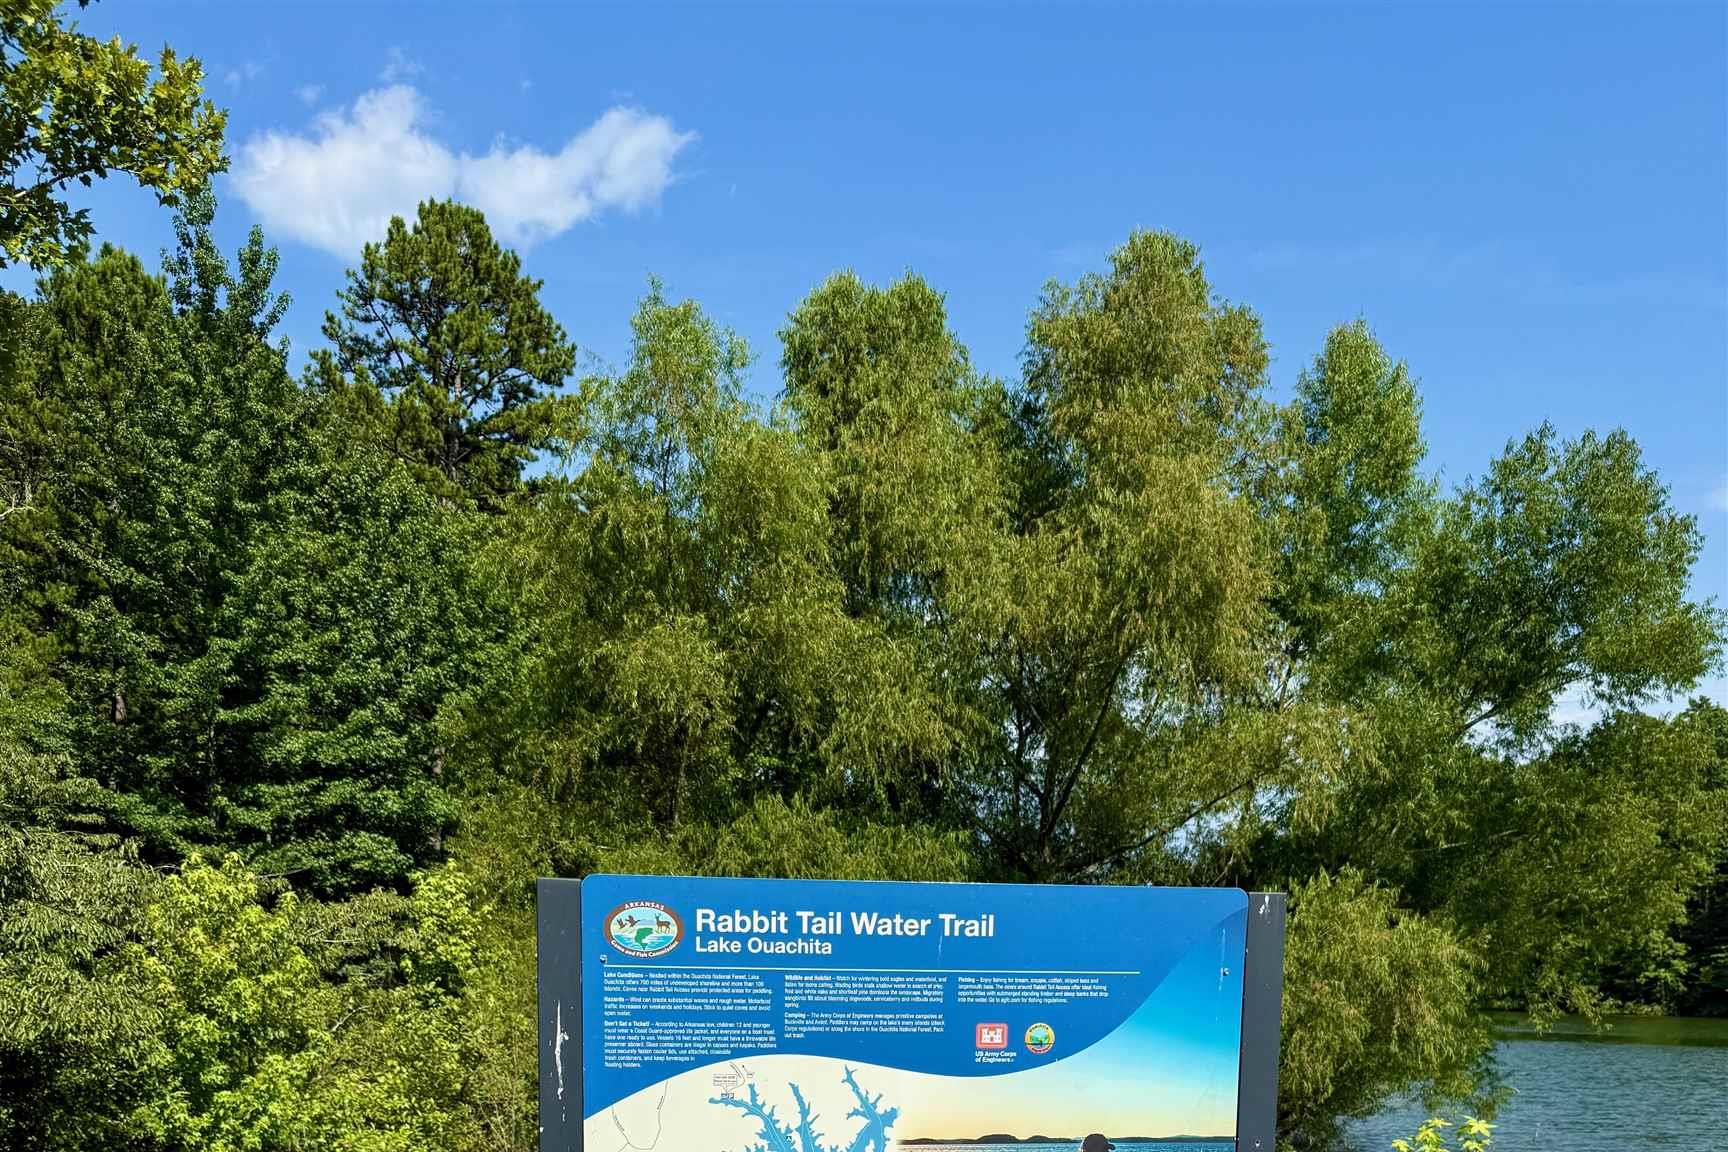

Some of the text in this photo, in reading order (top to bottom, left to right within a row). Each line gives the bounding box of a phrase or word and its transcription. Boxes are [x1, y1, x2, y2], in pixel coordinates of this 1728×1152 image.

[624, 901, 665, 910] ARKANSAS
[696, 908, 994, 938] Rabbit Tail Water Trail
[696, 937, 832, 954] Lake Ouachita
